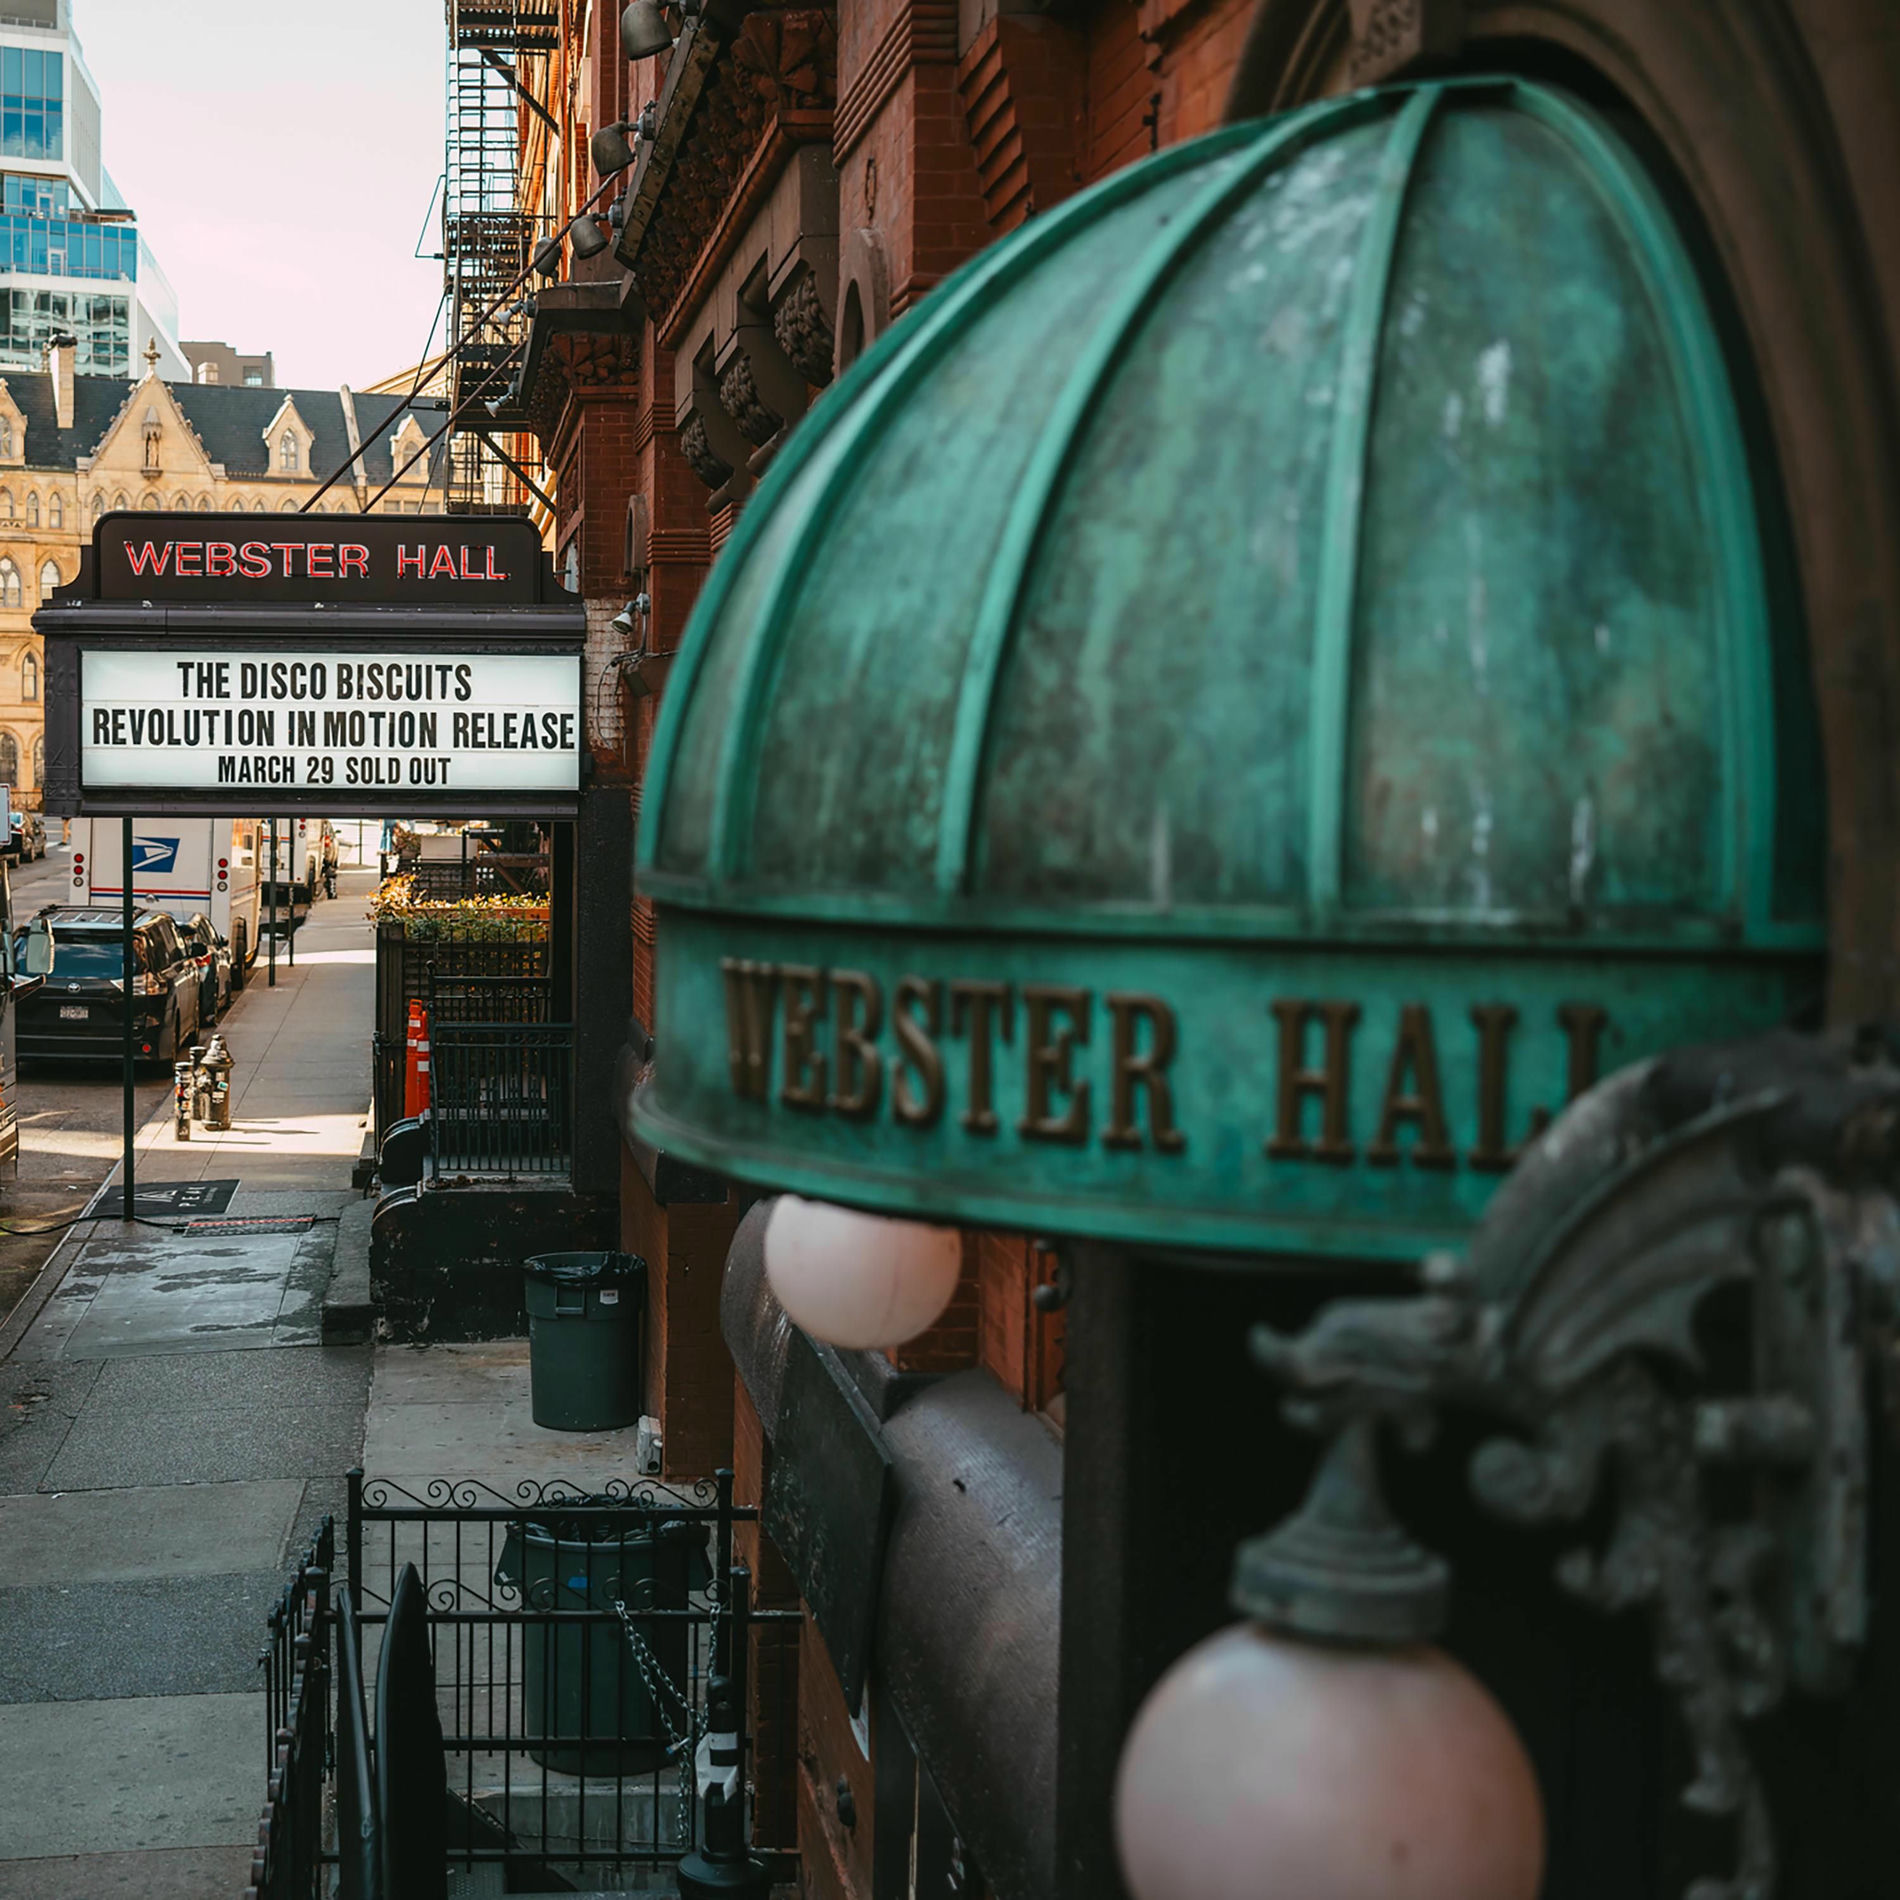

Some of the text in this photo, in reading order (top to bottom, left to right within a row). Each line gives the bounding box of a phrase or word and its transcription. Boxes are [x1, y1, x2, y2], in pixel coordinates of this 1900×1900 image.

[124, 540, 511, 581] WEBSTER HALL
[177, 661, 472, 702] THE DISCO BISCUITS
[93, 708, 575, 750] REVOLUTION IN MOTION RELEASE
[218, 755, 451, 785] MARCH 29 SOLD OUT
[721, 957, 1186, 1154] WEBSTER
